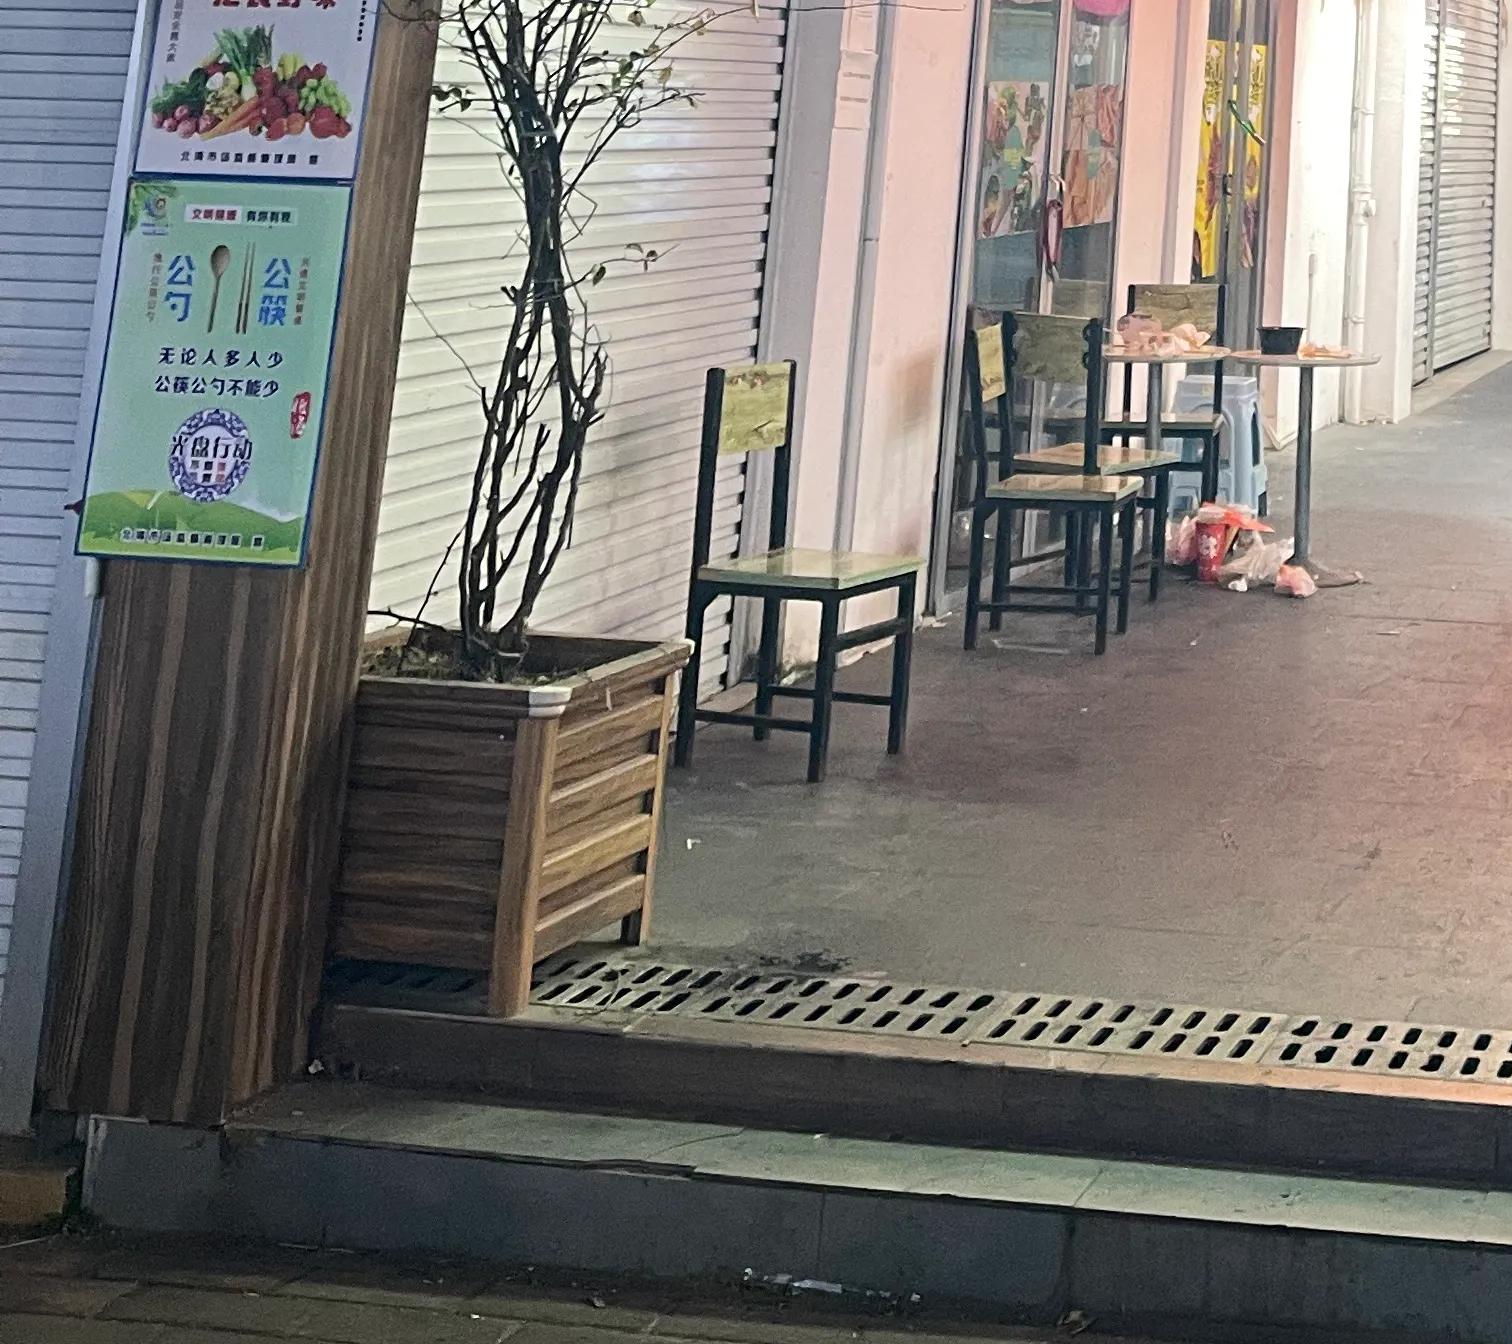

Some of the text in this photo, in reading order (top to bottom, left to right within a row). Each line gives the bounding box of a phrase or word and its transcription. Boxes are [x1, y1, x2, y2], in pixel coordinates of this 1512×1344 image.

[163, 254, 195, 324] 公勺
[257, 257, 292, 327] 公筷
[158, 347, 284, 369] 无论人多人少
[154, 374, 280, 399] 公筷公勺不能少
[170, 435, 252, 461] 光盘行动
